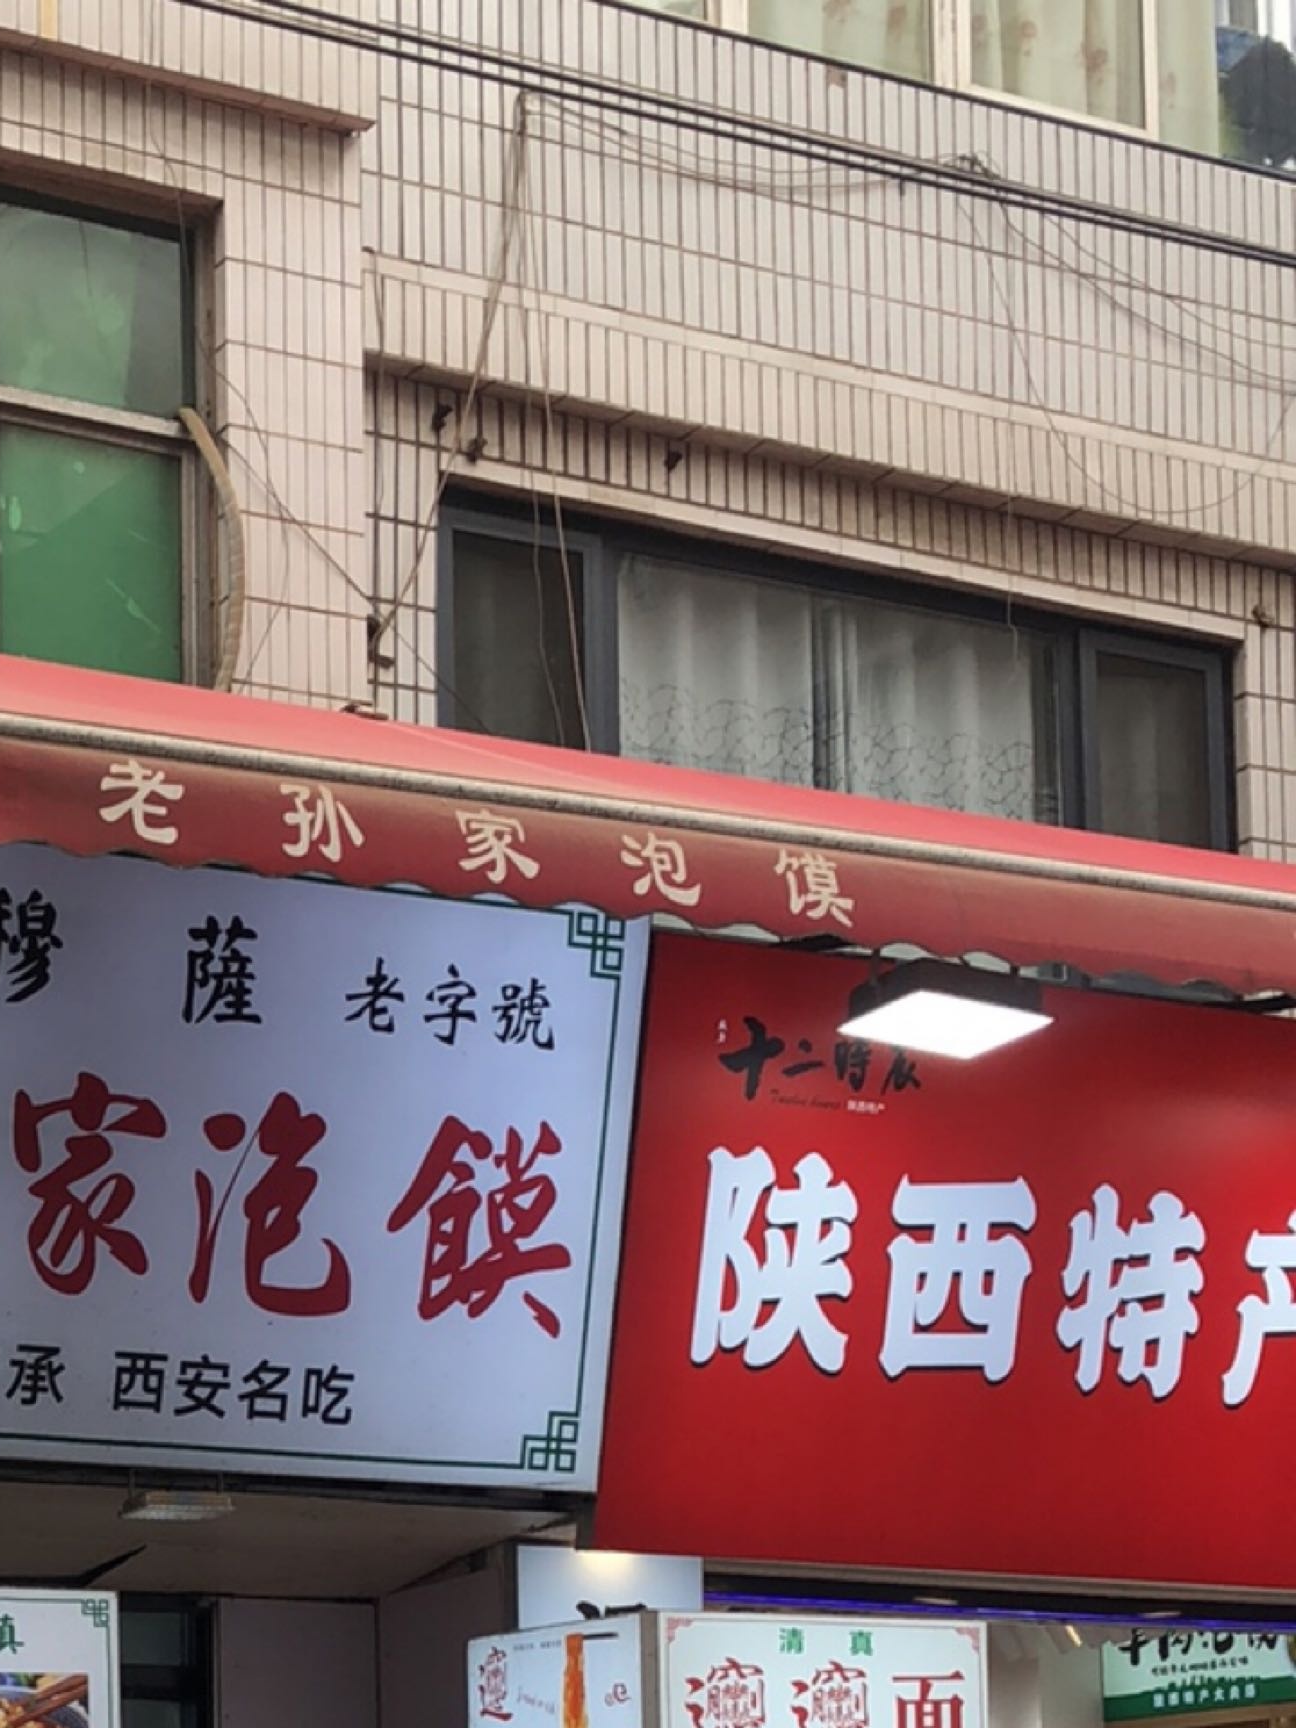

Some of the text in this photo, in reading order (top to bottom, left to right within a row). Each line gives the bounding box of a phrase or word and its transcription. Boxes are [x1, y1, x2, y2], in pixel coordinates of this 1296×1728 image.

[97, 757, 854, 928] 老孙家泡馍
[112, 1350, 356, 1428] 西安名吃
[778, 1628, 874, 1656] 清真
